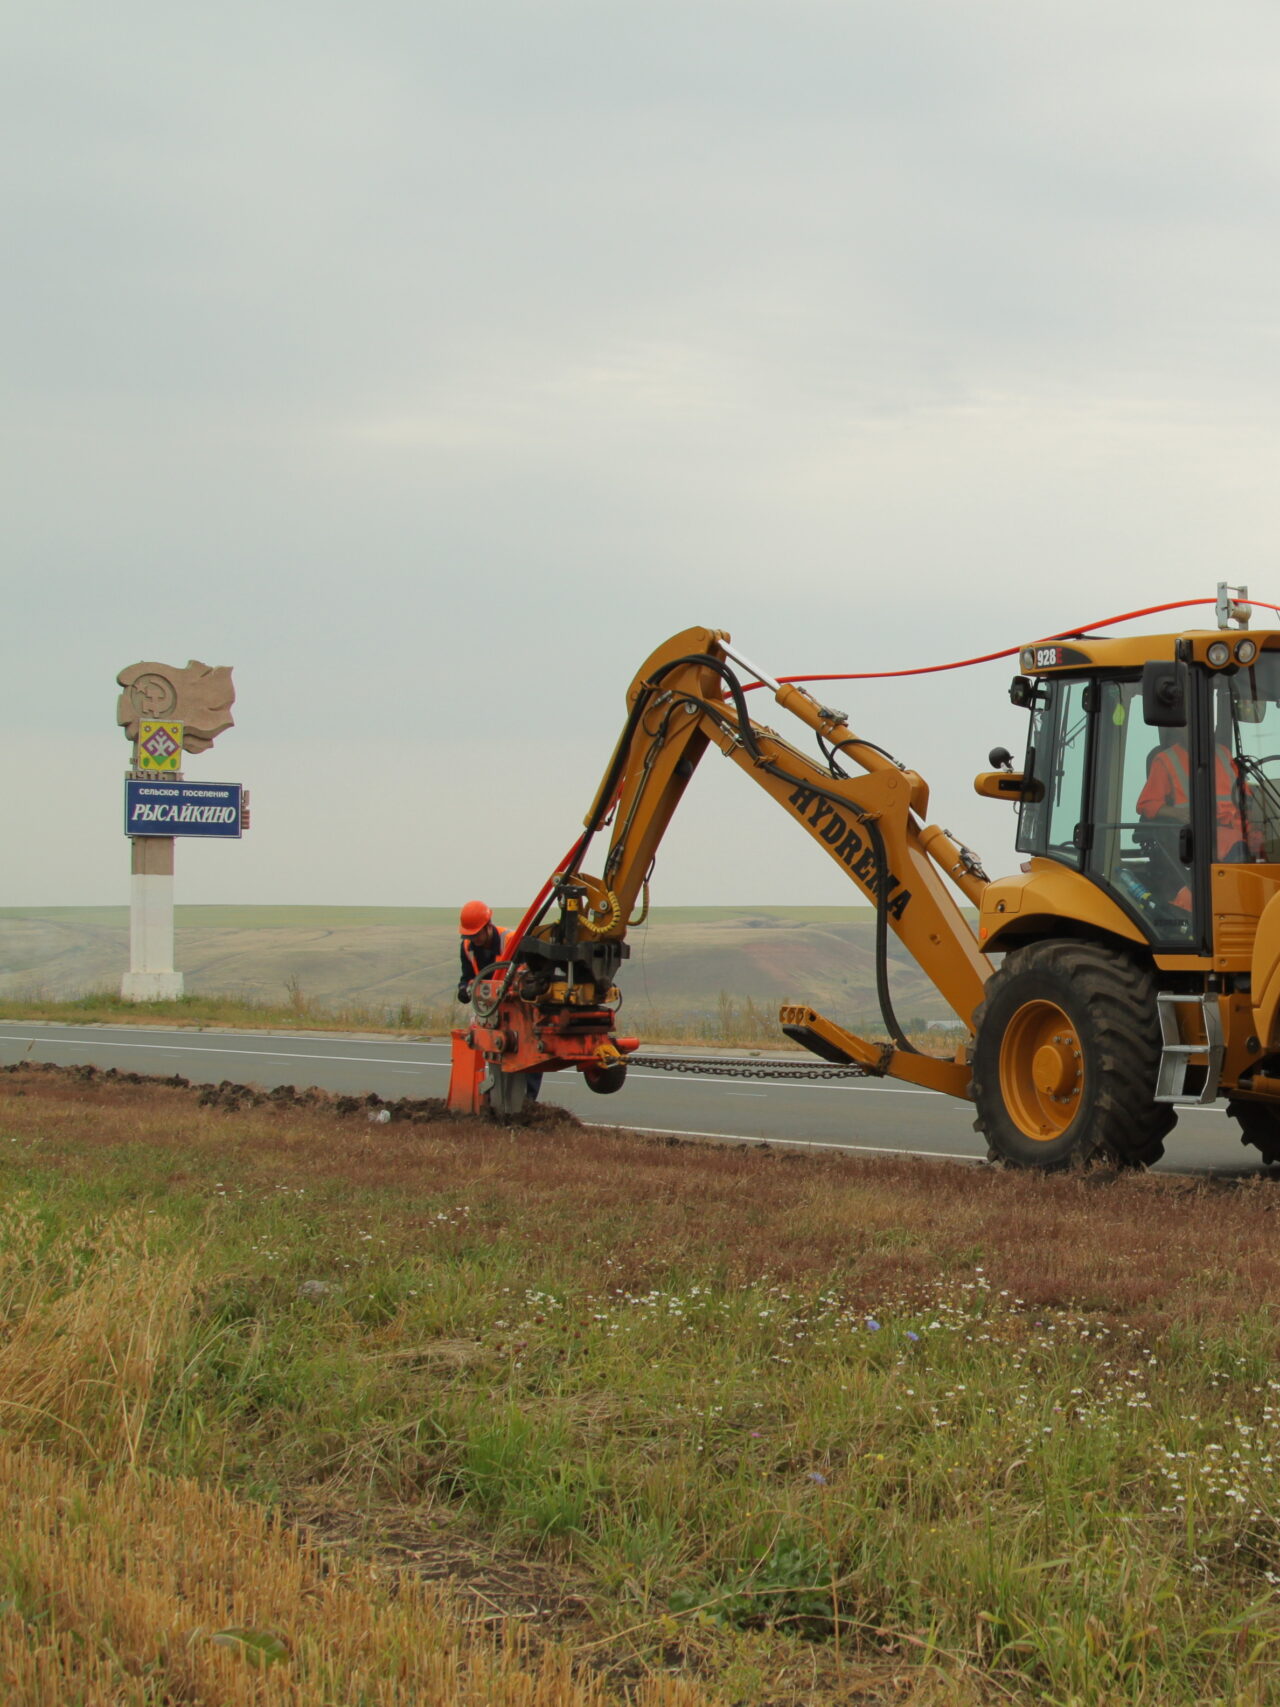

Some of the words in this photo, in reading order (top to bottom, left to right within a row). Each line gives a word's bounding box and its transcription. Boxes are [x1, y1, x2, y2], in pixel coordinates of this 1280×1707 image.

[1037, 647, 1063, 667] 928E
[139, 788, 179, 796] сельское
[182, 790, 229, 798] поселение
[132, 803, 236, 823] РЫСАЙКИНО
[788, 777, 912, 921] HYDREMA
